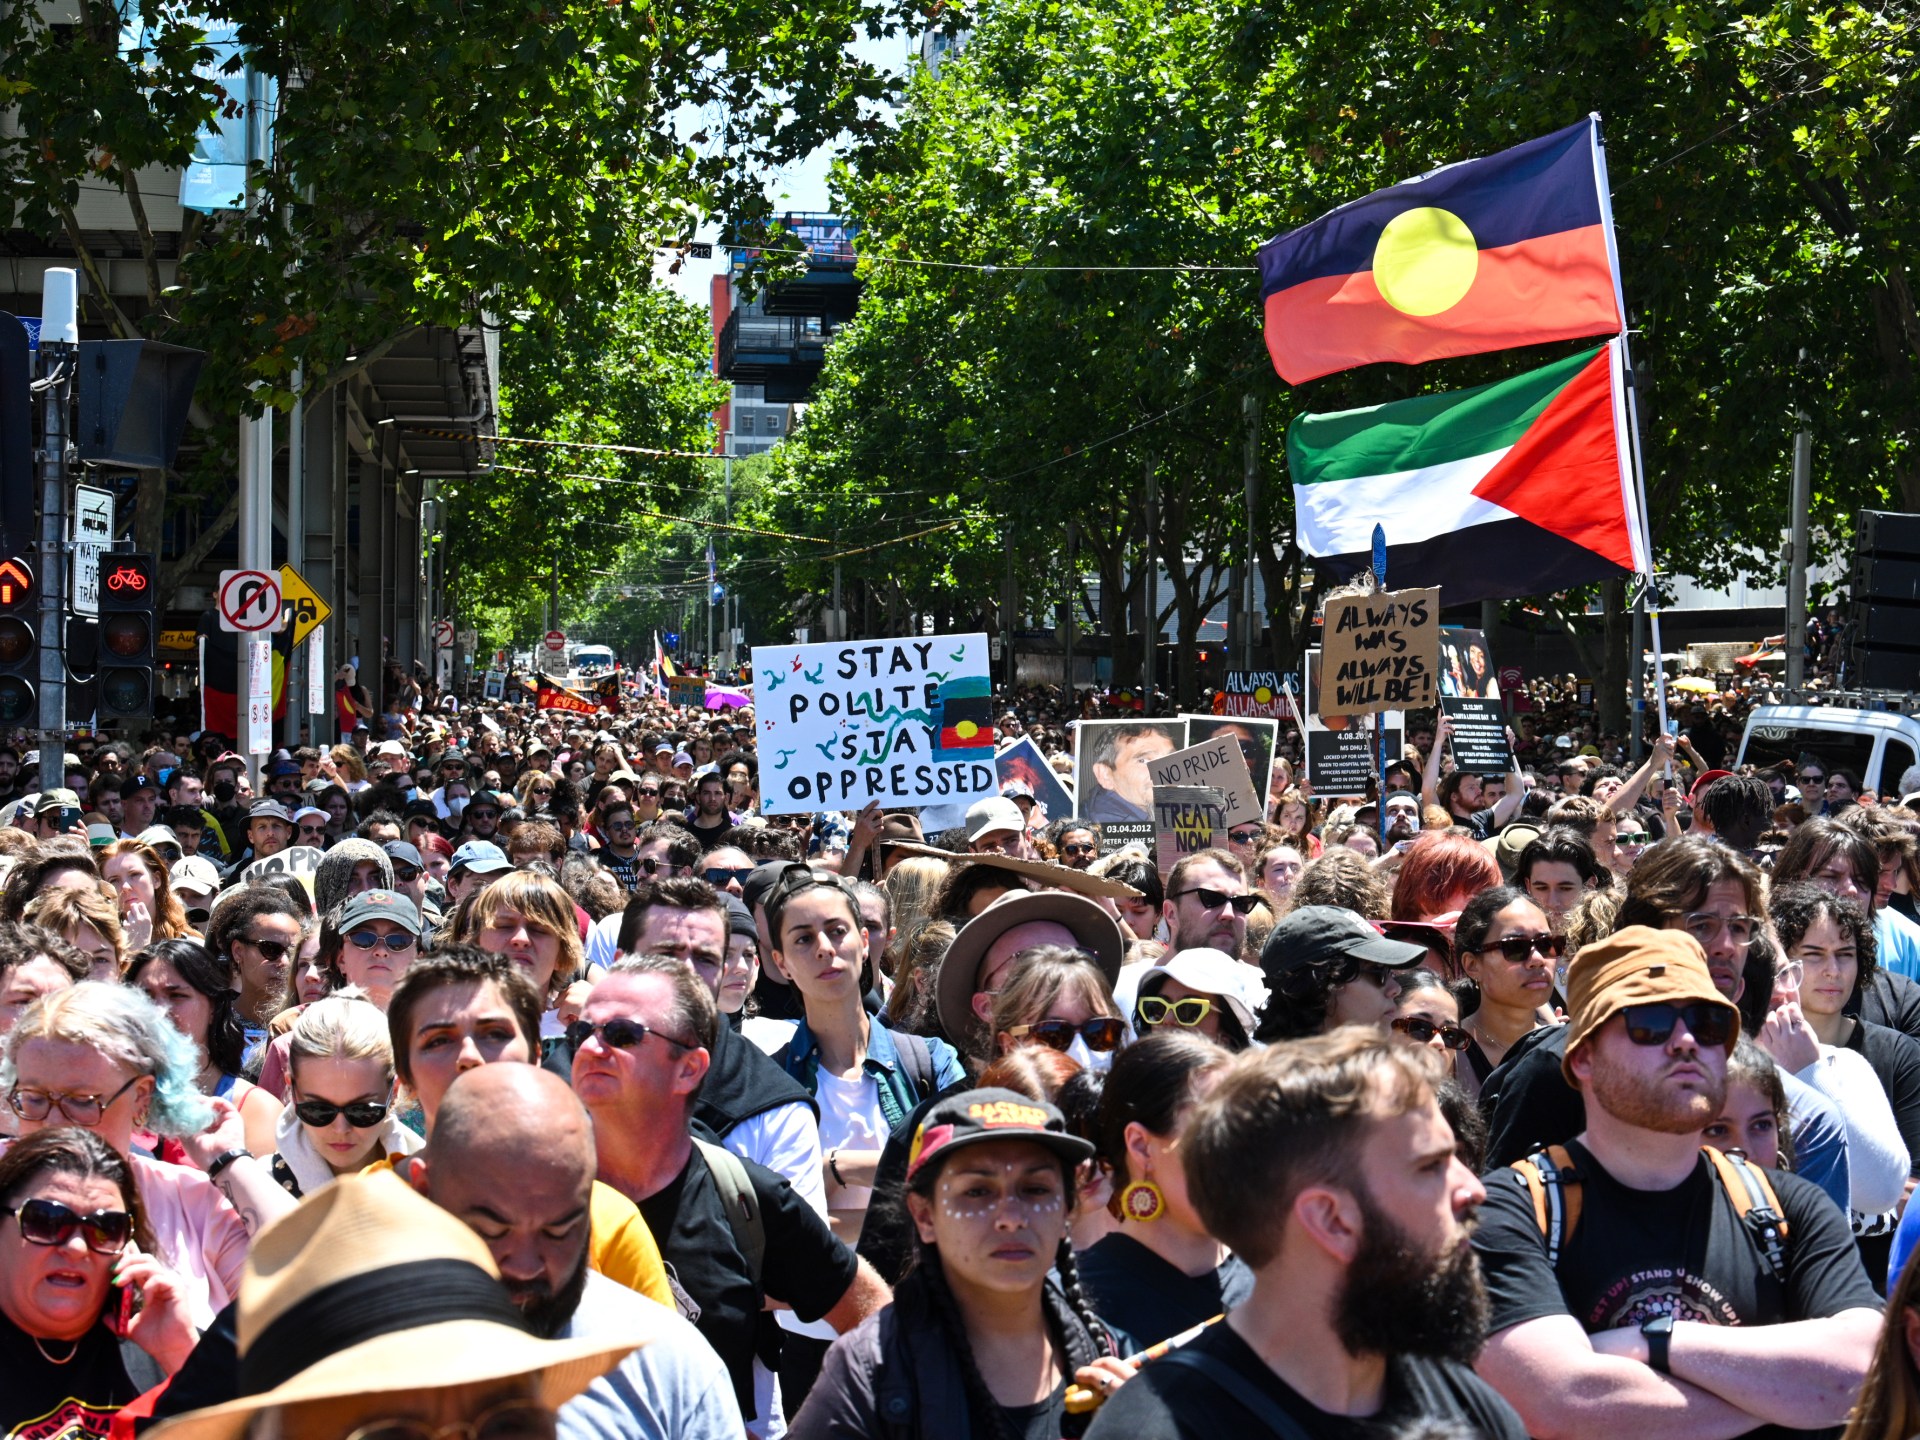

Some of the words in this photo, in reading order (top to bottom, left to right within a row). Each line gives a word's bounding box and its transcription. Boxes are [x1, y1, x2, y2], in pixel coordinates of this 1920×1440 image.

[796, 226, 848, 243] FILA
[692, 247, 711, 258] 213
[1335, 599, 1429, 634] ALWAYS
[1355, 630, 1407, 653] WAS
[837, 641, 933, 680] STAY
[1336, 655, 1425, 681] ALWAYS
[1225, 671, 1273, 693] ALWAYS
[1337, 678, 1381, 706] WILL
[1383, 673, 1430, 703] BE!
[790, 683, 941, 724] POLITE
[841, 725, 939, 760] STAY
[1337, 732, 1373, 740] 4.08.204
[1158, 763, 1181, 784] NO
[1183, 745, 1231, 778] PRIDE
[137, 775, 146, 786] P
[788, 763, 993, 804] OPPRESSED
[1106, 824, 1152, 833] 03.04.2012
[1155, 802, 1227, 830] TREATY
[1102, 837, 1122, 845] PETER
[1147, 836, 1155, 844] 56
[1175, 831, 1212, 853] NOW
[1589, 1297, 1609, 1323] GET
[1608, 1277, 1630, 1298] UP!
[1631, 1269, 1673, 1284] STAND
[1685, 1274, 1724, 1303] SHOW
[1721, 1302, 1742, 1326] UP!
